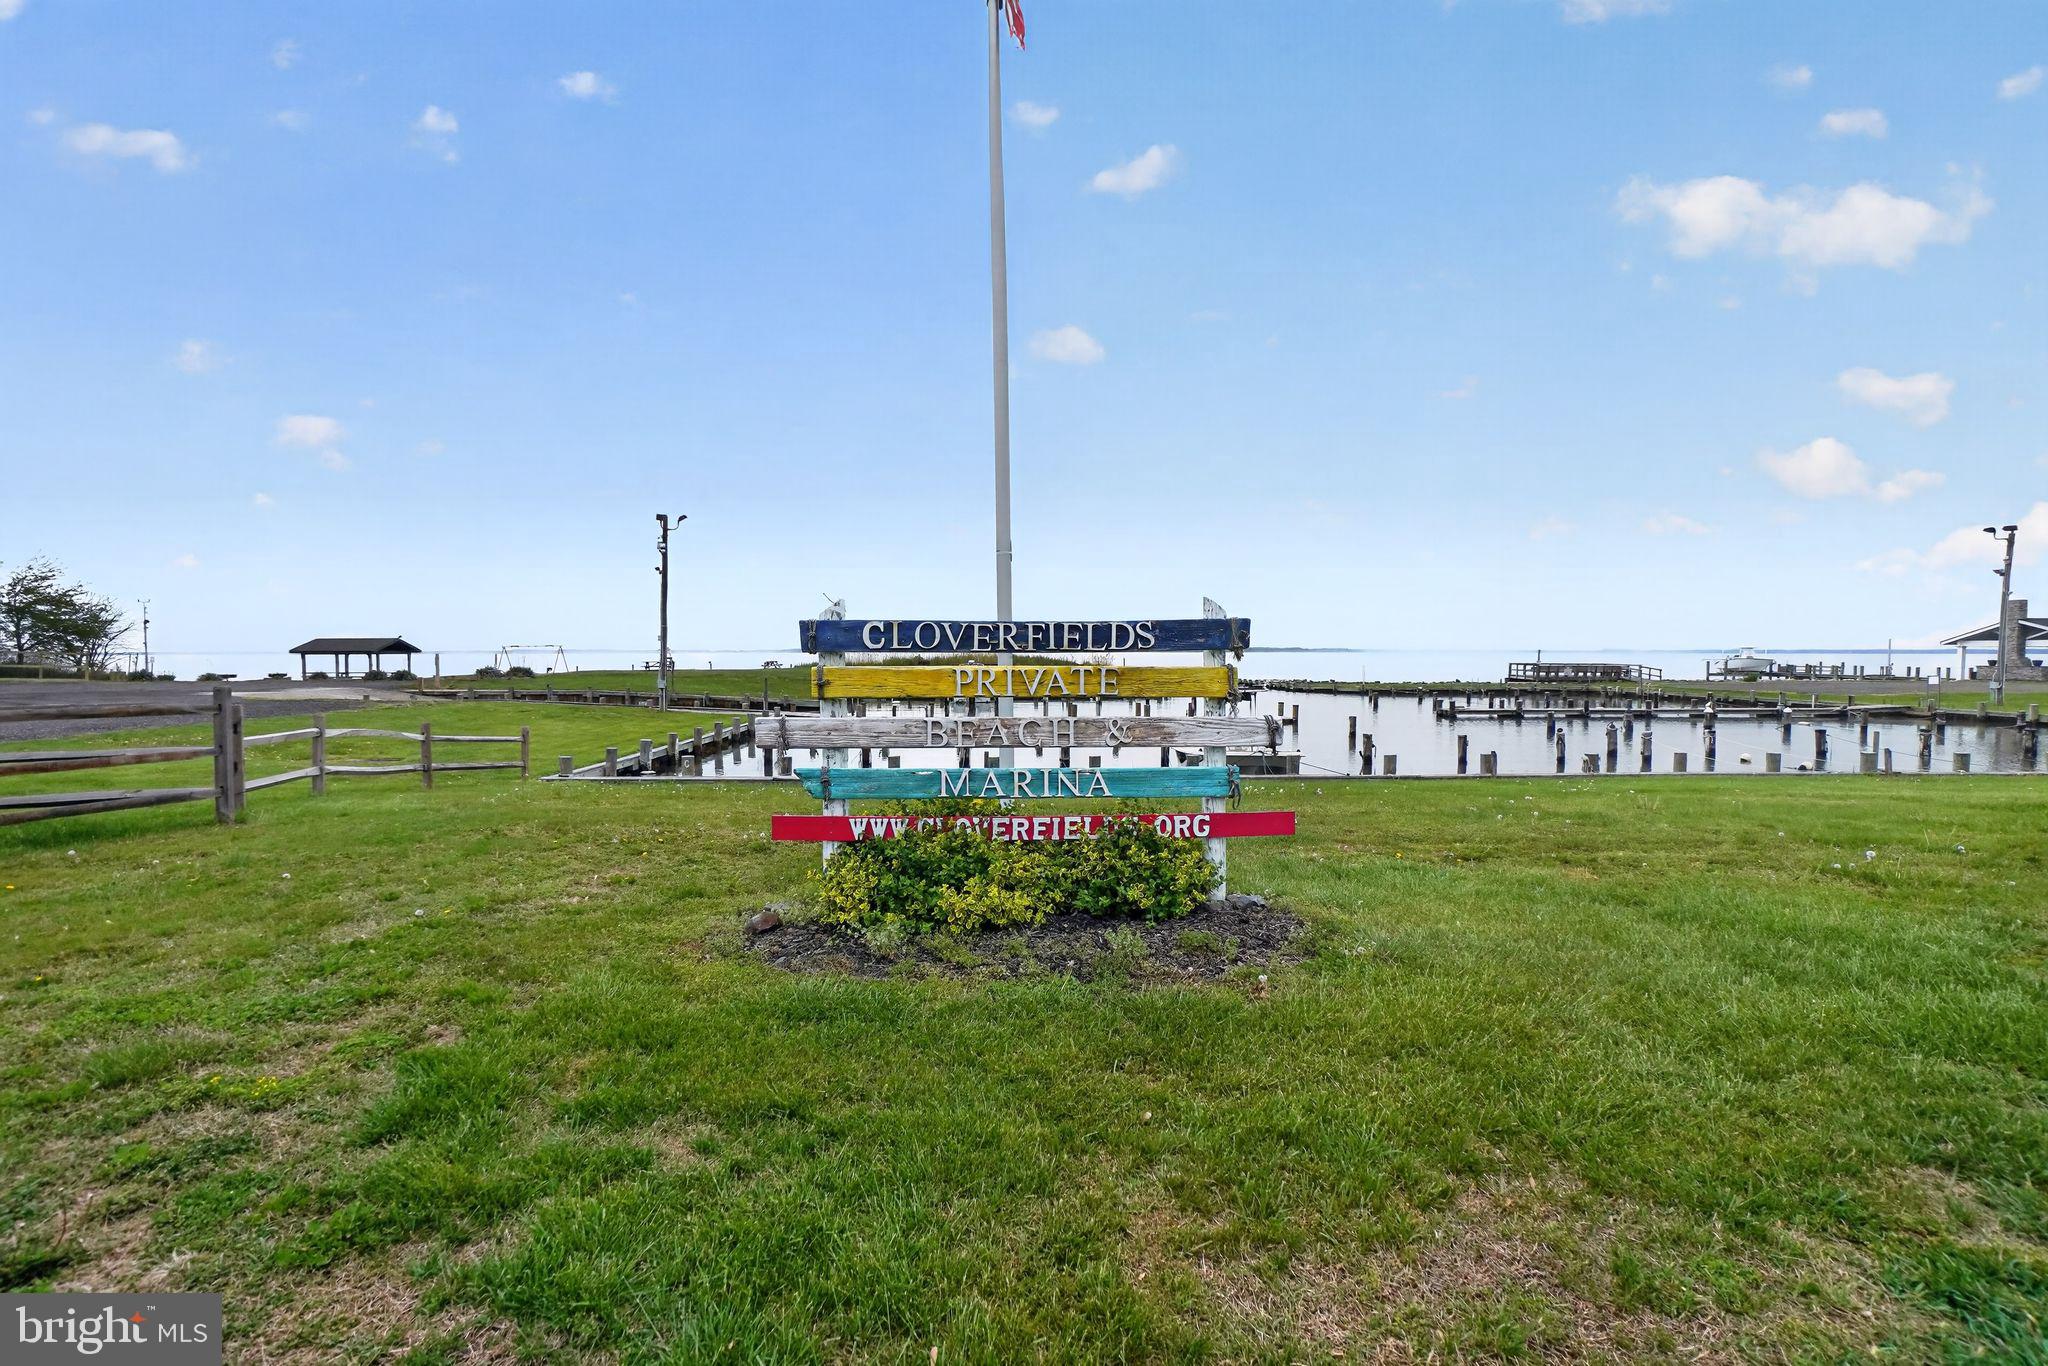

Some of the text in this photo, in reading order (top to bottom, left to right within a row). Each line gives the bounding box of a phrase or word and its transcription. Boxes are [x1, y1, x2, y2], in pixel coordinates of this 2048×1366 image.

[862, 620, 1155, 651] CLOVERFIELDS
[953, 667, 1121, 697] PRIVATE
[923, 718, 1133, 748] BEACH &
[938, 768, 1113, 798] MARINA
[849, 813, 1211, 842] WWWCOVERFIELORG
